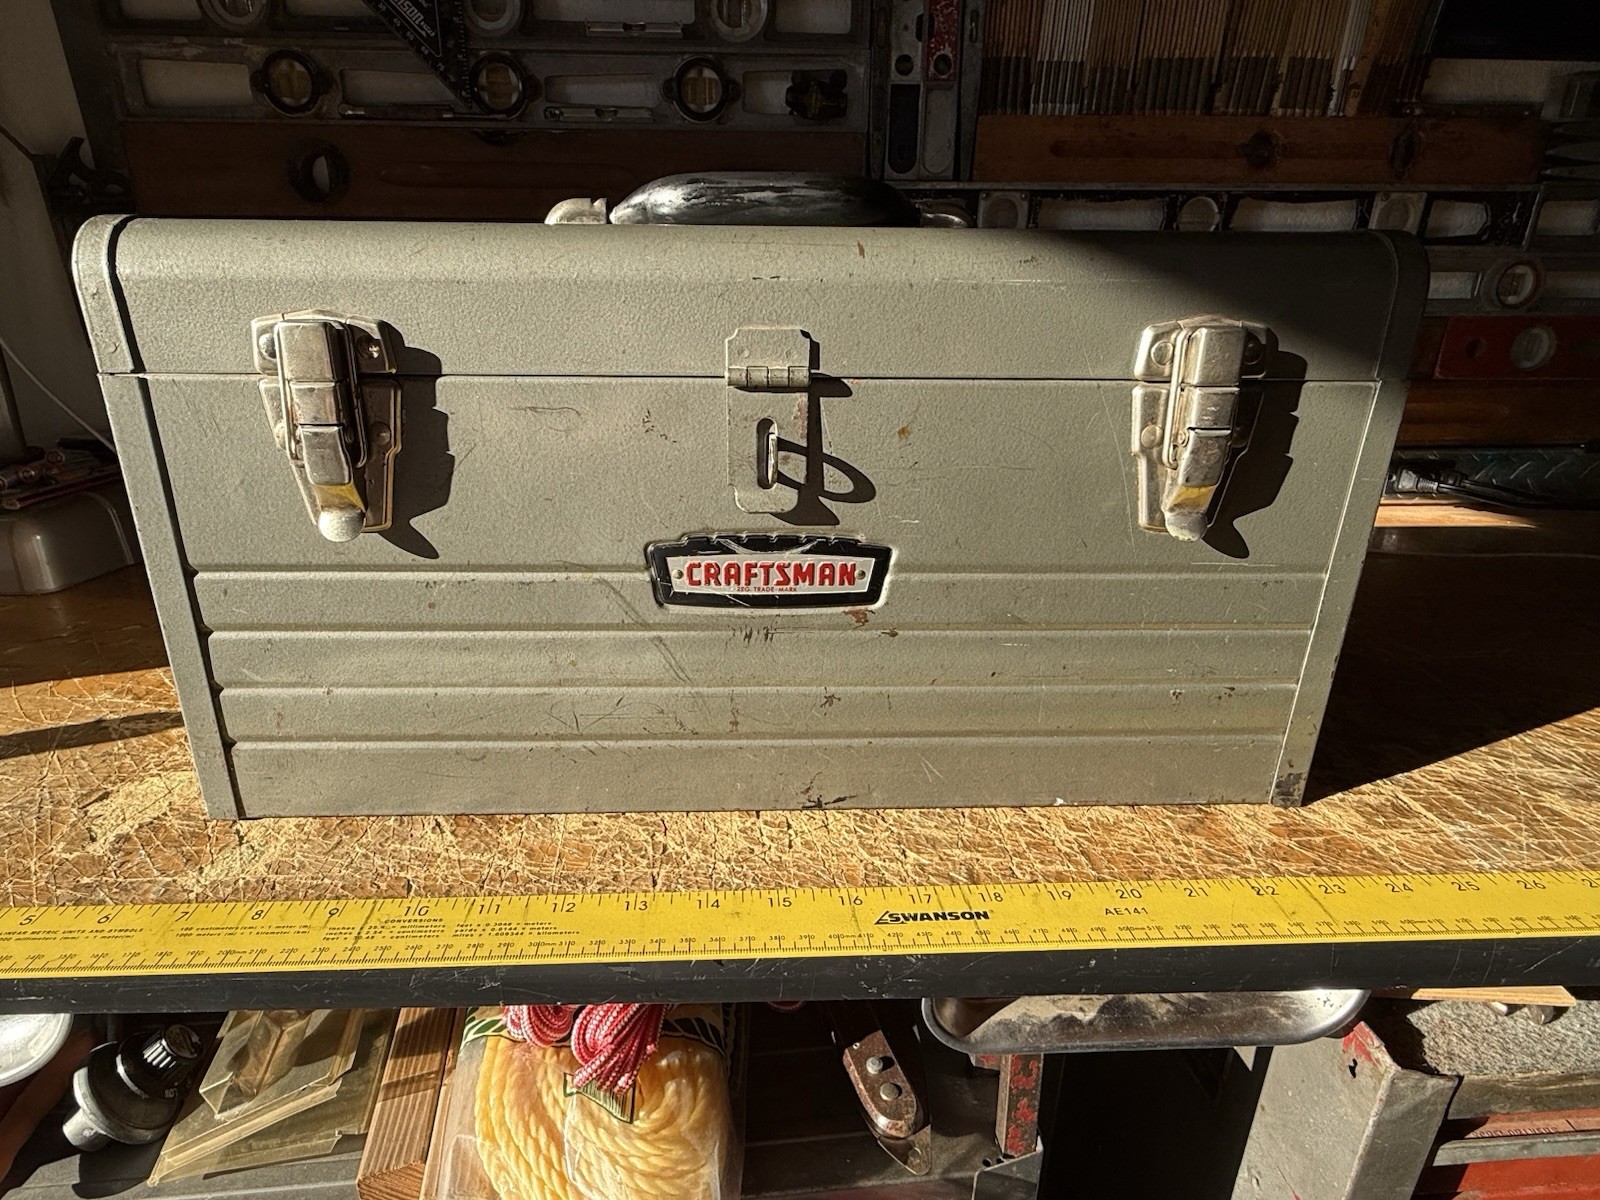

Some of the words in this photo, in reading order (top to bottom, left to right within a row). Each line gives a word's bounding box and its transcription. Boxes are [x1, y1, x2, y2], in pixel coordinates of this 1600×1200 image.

[685, 560, 856, 587] CRAFTSMAN
[19, 915, 36, 926] 5
[97, 914, 112, 924] 6
[175, 912, 190, 922] 7
[251, 910, 264, 920] 8
[327, 908, 340, 919] 9
[404, 906, 430, 916] 10
[478, 904, 500, 914] 11
[552, 902, 576, 912] 12
[625, 900, 648, 910] 13
[696, 899, 720, 910] 14
[768, 898, 792, 908] 15
[839, 896, 863, 906] 16
[910, 894, 932, 904] 17
[978, 892, 1004, 902] 18
[1048, 890, 1072, 900] 19
[1116, 888, 1142, 900] 20
[1183, 886, 1208, 897] 21
[1251, 886, 1280, 896] 22
[1318, 884, 1346, 894] 23
[1385, 883, 1414, 893] 24
[1451, 881, 1480, 892] 25
[1516, 880, 1546, 890] 26
[1105, 907, 1148, 916] AE141
[887, 911, 990, 922] SWANSON
